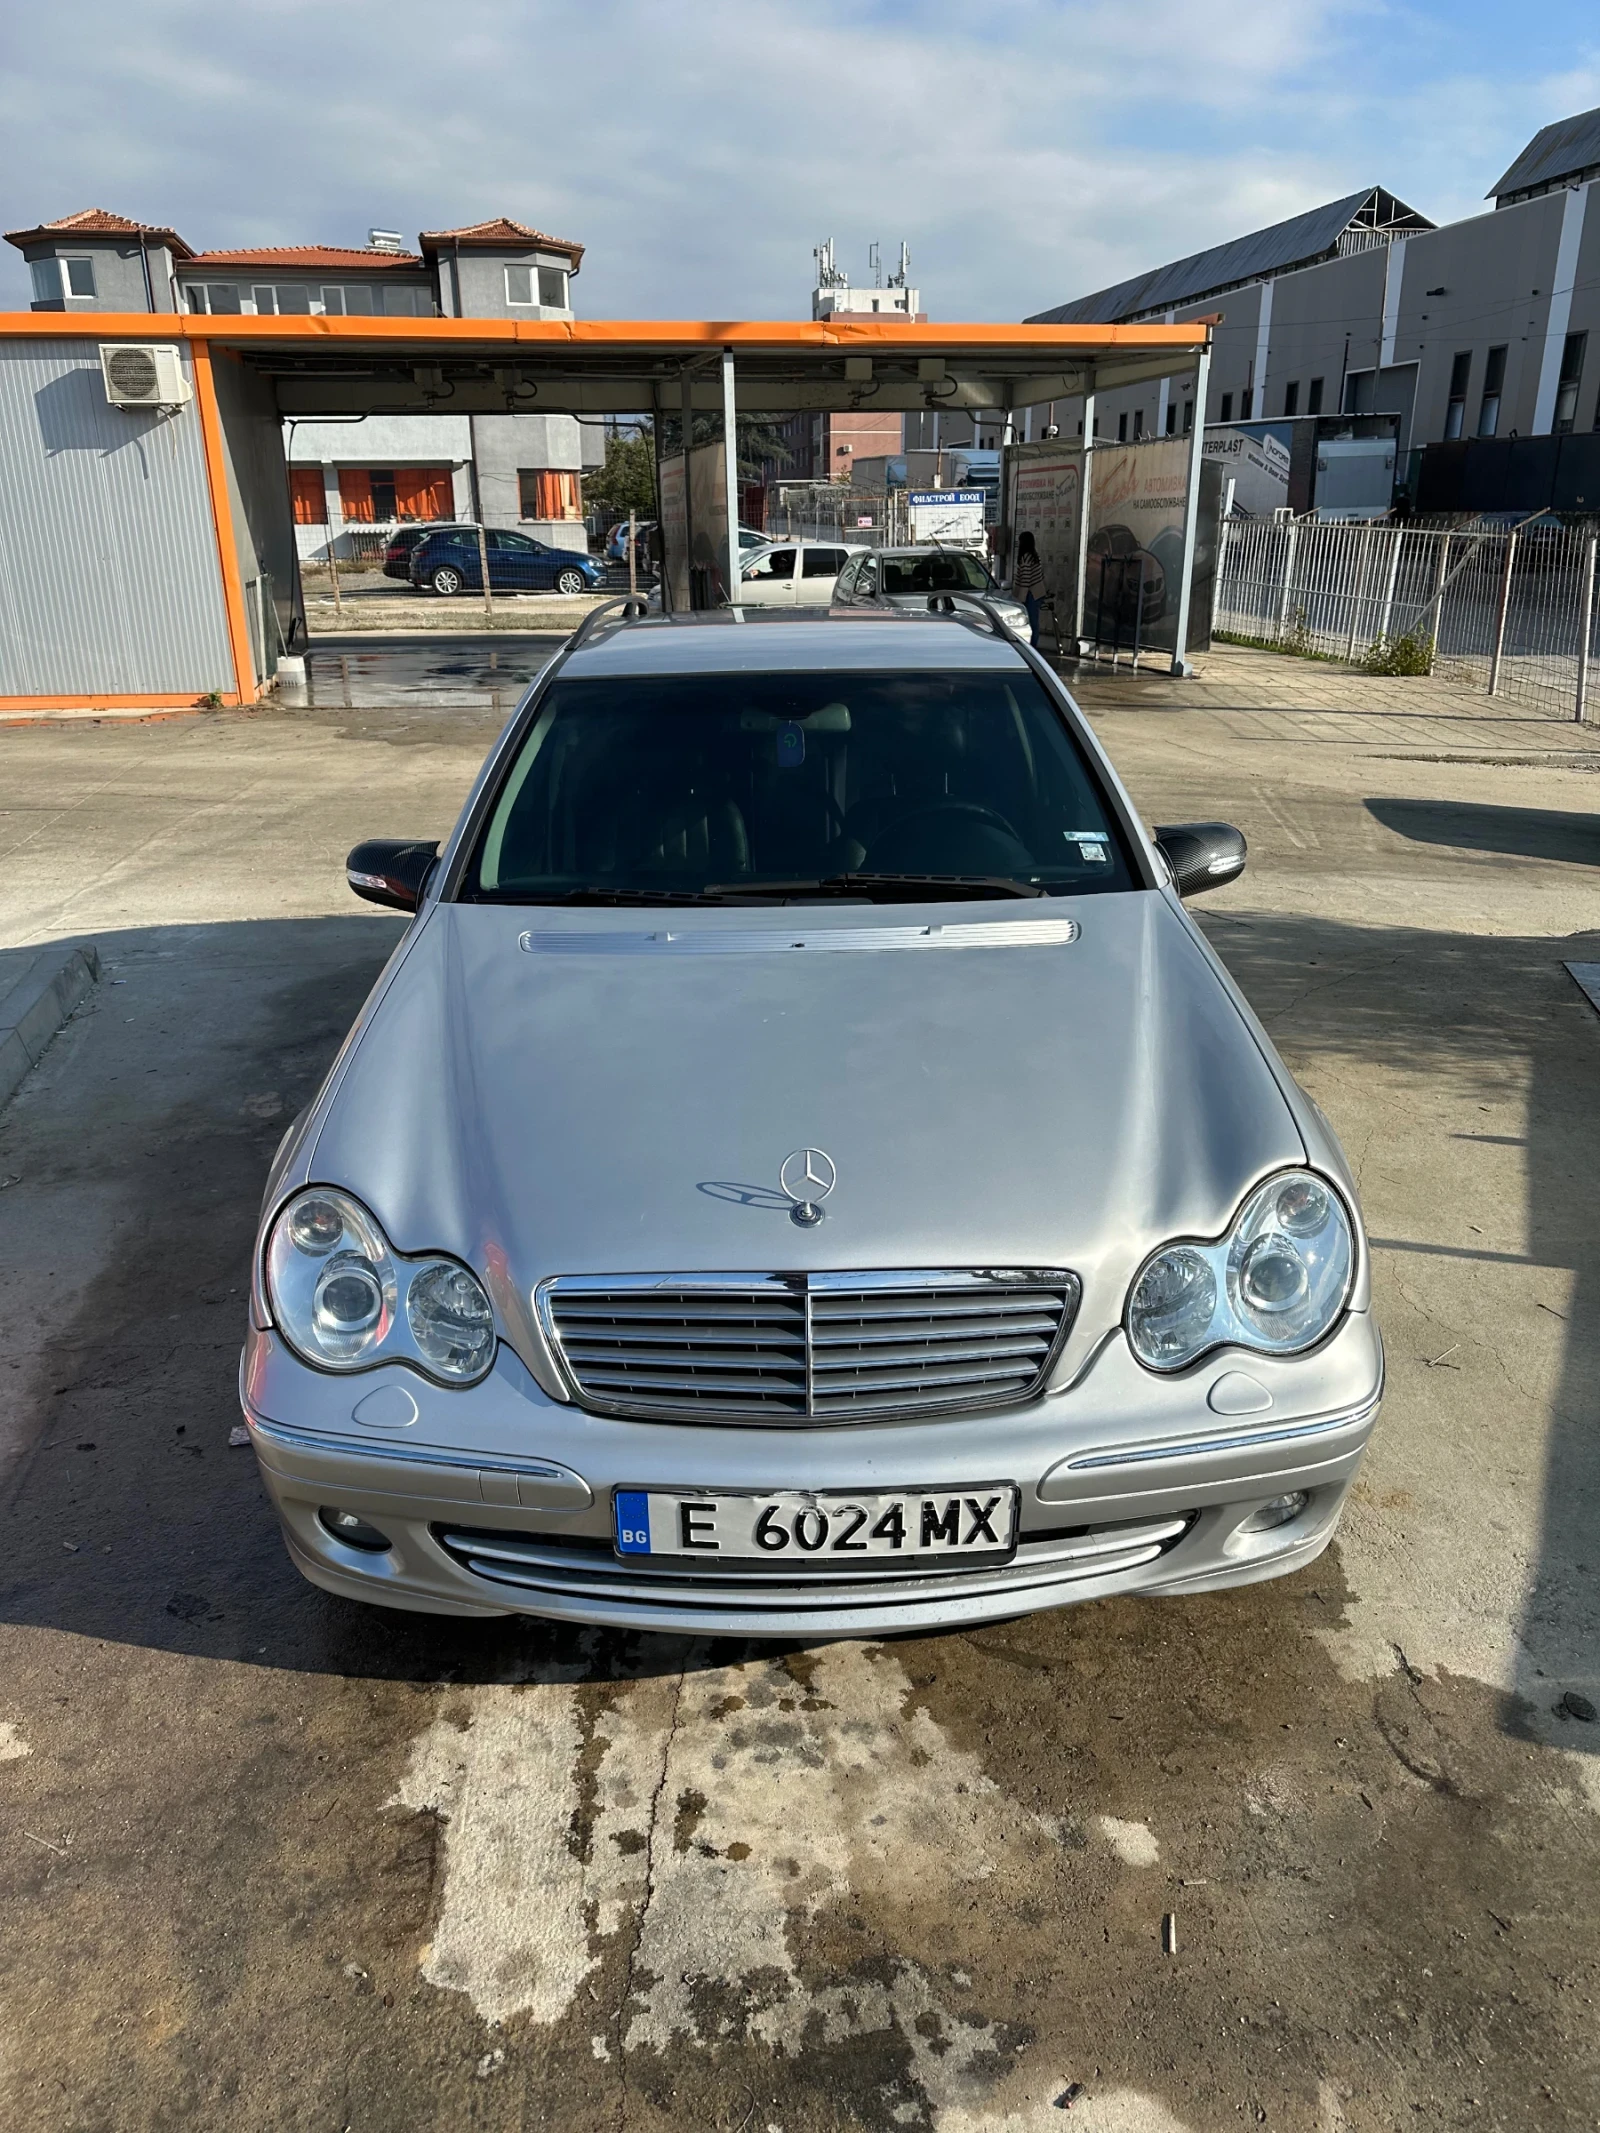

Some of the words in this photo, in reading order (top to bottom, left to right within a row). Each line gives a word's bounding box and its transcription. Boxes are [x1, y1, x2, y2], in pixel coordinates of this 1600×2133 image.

[959, 493, 980, 502] ЕООД
[680, 1502, 720, 1549] E
[755, 1502, 907, 1551] 6024
[920, 1496, 1002, 1547] MX
[622, 1529, 647, 1543] BG
